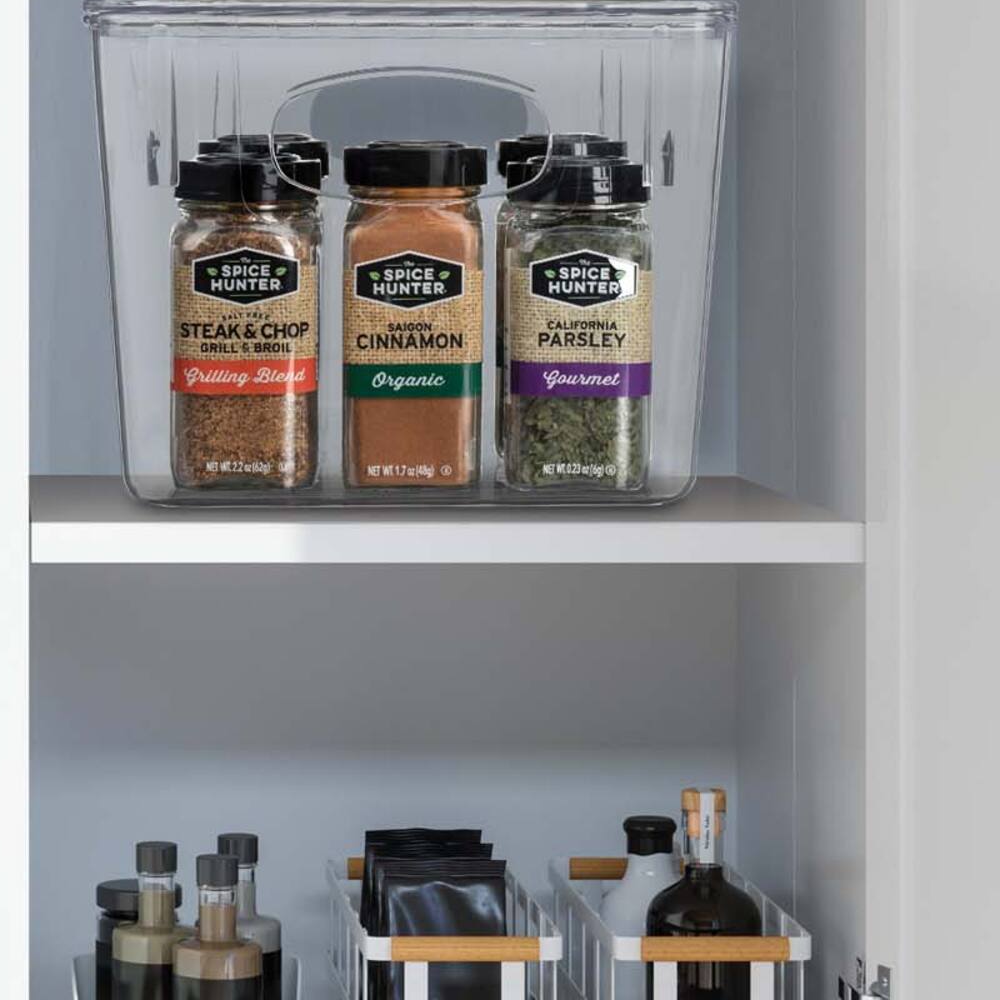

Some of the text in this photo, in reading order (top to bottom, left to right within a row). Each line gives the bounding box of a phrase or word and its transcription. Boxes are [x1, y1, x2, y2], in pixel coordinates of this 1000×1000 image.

[221, 264, 271, 277] SPICE
[383, 267, 435, 281] SPICE
[559, 267, 611, 280] SPICE
[210, 279, 281, 292] HUNTER
[372, 282, 445, 295] HUNTER
[548, 281, 620, 294] HUNTER
[180, 322, 310, 339] STEAK & CHOP
[388, 322, 432, 332] SAIGON
[547, 320, 617, 330] CALIFORNIA
[356, 333, 463, 349] CINNAMON
[538, 332, 626, 348] PARSLEY
[200, 342, 238, 353] GRILL
[254, 342, 292, 353] BROIL
[184, 367, 306, 387] Grilling Blend
[371, 371, 446, 391] Organic
[543, 369, 620, 389] Gourmet
[206, 462, 218, 472] NET
[367, 465, 379, 476] NET
[542, 464, 555, 475] NET
